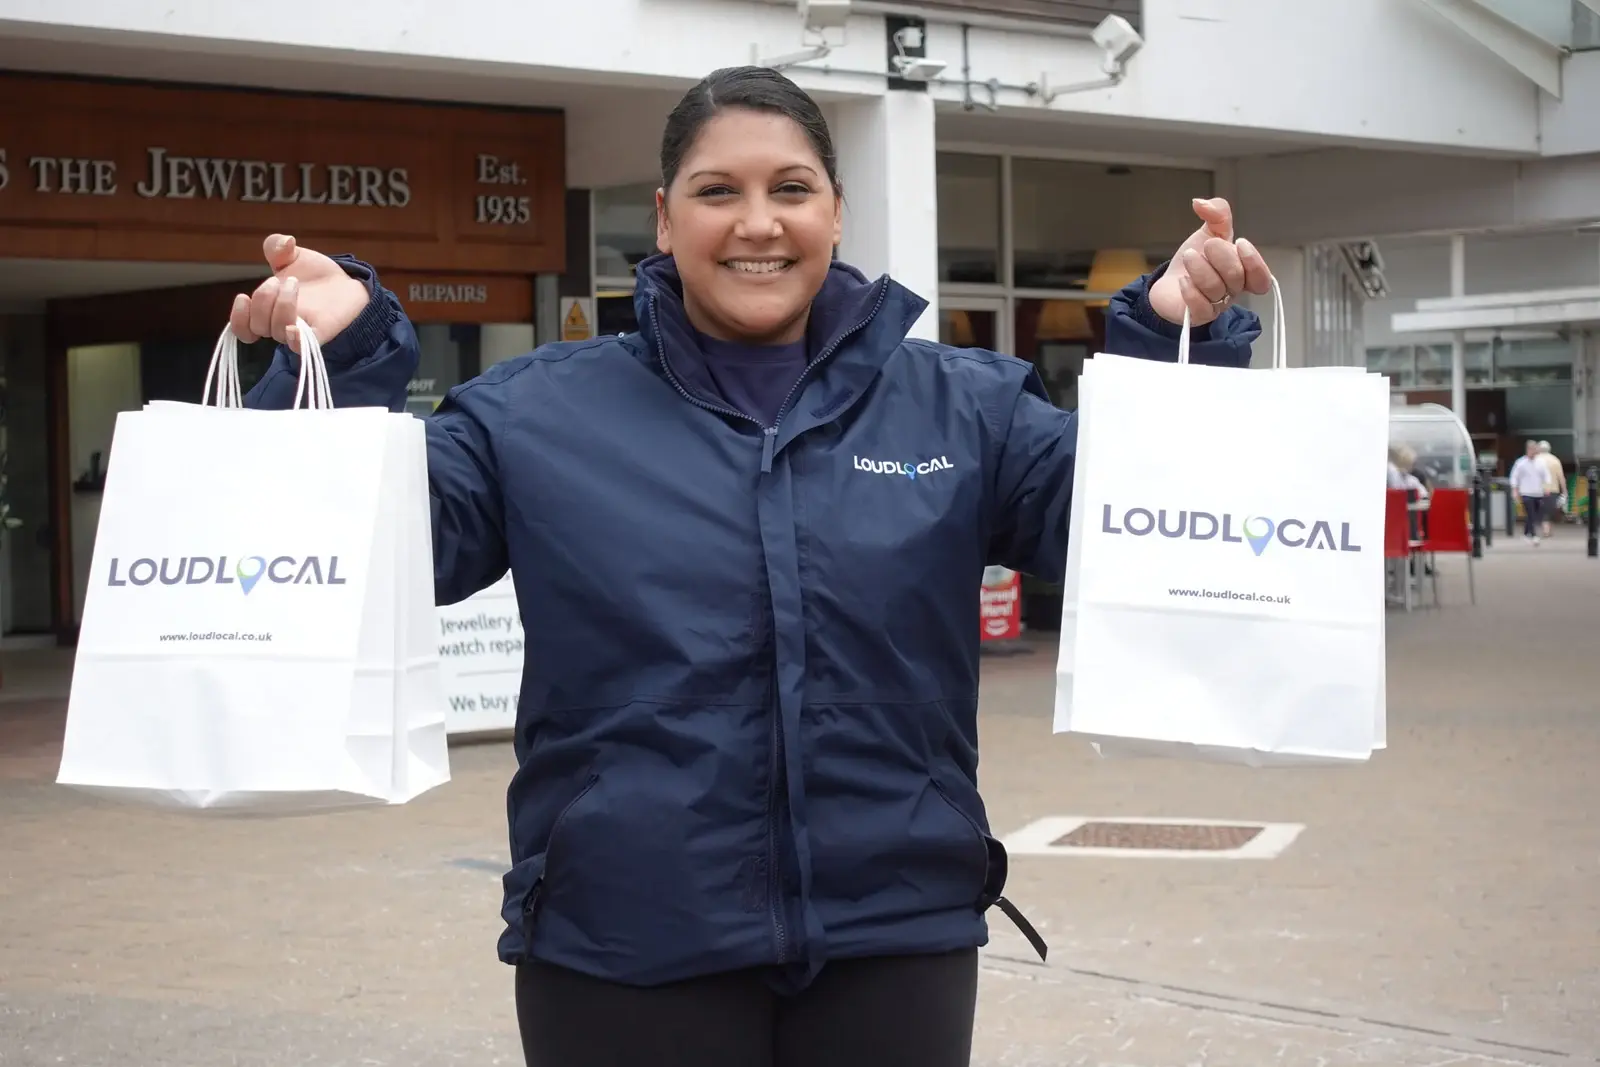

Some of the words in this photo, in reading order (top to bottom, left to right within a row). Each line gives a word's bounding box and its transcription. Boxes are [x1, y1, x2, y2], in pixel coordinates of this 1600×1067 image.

[29, 156, 118, 196] THE
[136, 147, 411, 208] JEWELLERS
[476, 153, 528, 186] Est.
[476, 195, 530, 224] 1935
[408, 282, 488, 302] REPAIRS
[853, 455, 954, 480] LOUDLOCAL
[1101, 503, 1362, 557] LOUDLOCAL
[107, 555, 347, 596] LOUDLOCAL
[1168, 586, 1292, 605] www.loudlocal.co.uk
[159, 631, 273, 642] www.loudlocal.co.uk
[440, 613, 513, 637] Jewellery
[437, 637, 485, 657] watch
[448, 695, 476, 713] We
[480, 693, 510, 713] buy
